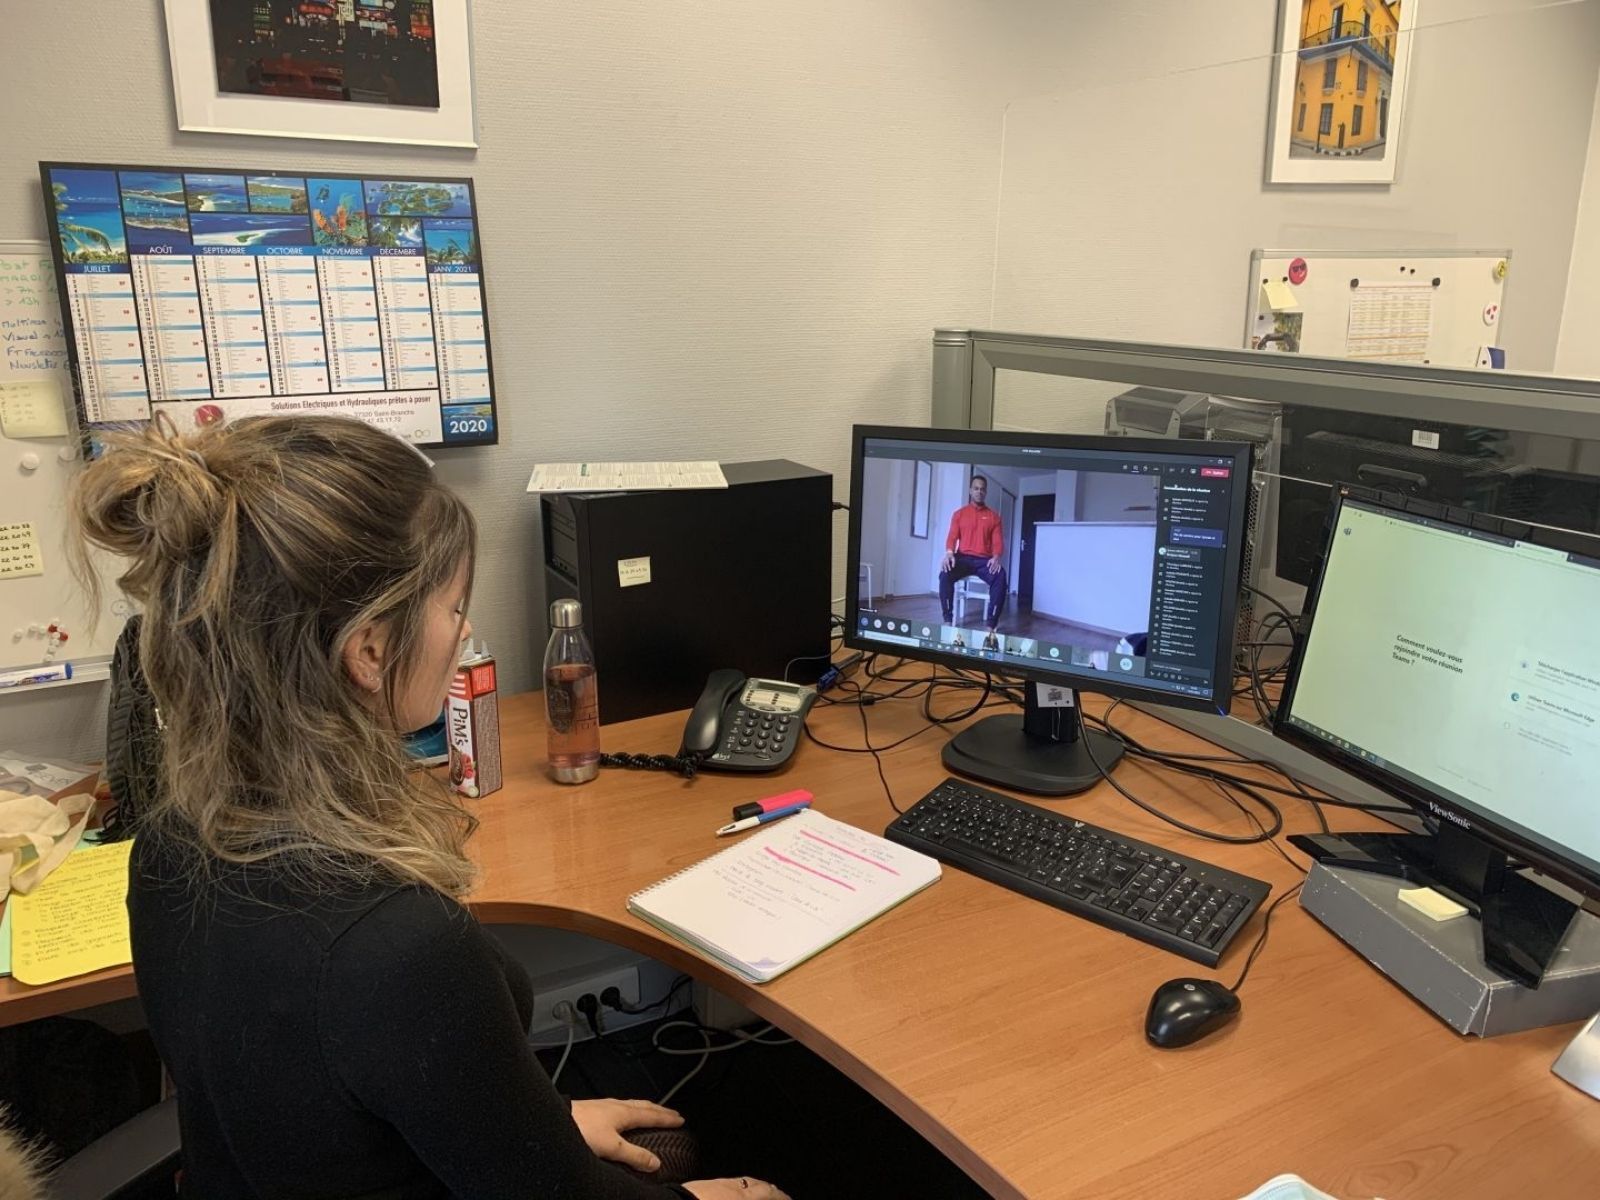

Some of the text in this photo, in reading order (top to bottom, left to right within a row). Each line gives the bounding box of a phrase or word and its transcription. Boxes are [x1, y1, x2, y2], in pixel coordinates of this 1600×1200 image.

[149, 243, 173, 254] AOÛT
[202, 246, 246, 255] SEPTEMBRE
[266, 246, 303, 255] OCTOBRE
[322, 247, 363, 256] NOVEMBRE
[83, 265, 112, 273] JUILLET
[270, 402, 302, 411] Solutions
[414, 396, 431, 405] poser
[449, 419, 488, 434] 2020
[1396, 634, 1464, 663] Comment voulez-vous
[1392, 651, 1410, 664] Teams
[1394, 644, 1463, 673] rejoindre votre réunion
[453, 706, 469, 747] PiM's
[1429, 801, 1471, 830] ViewSonic
